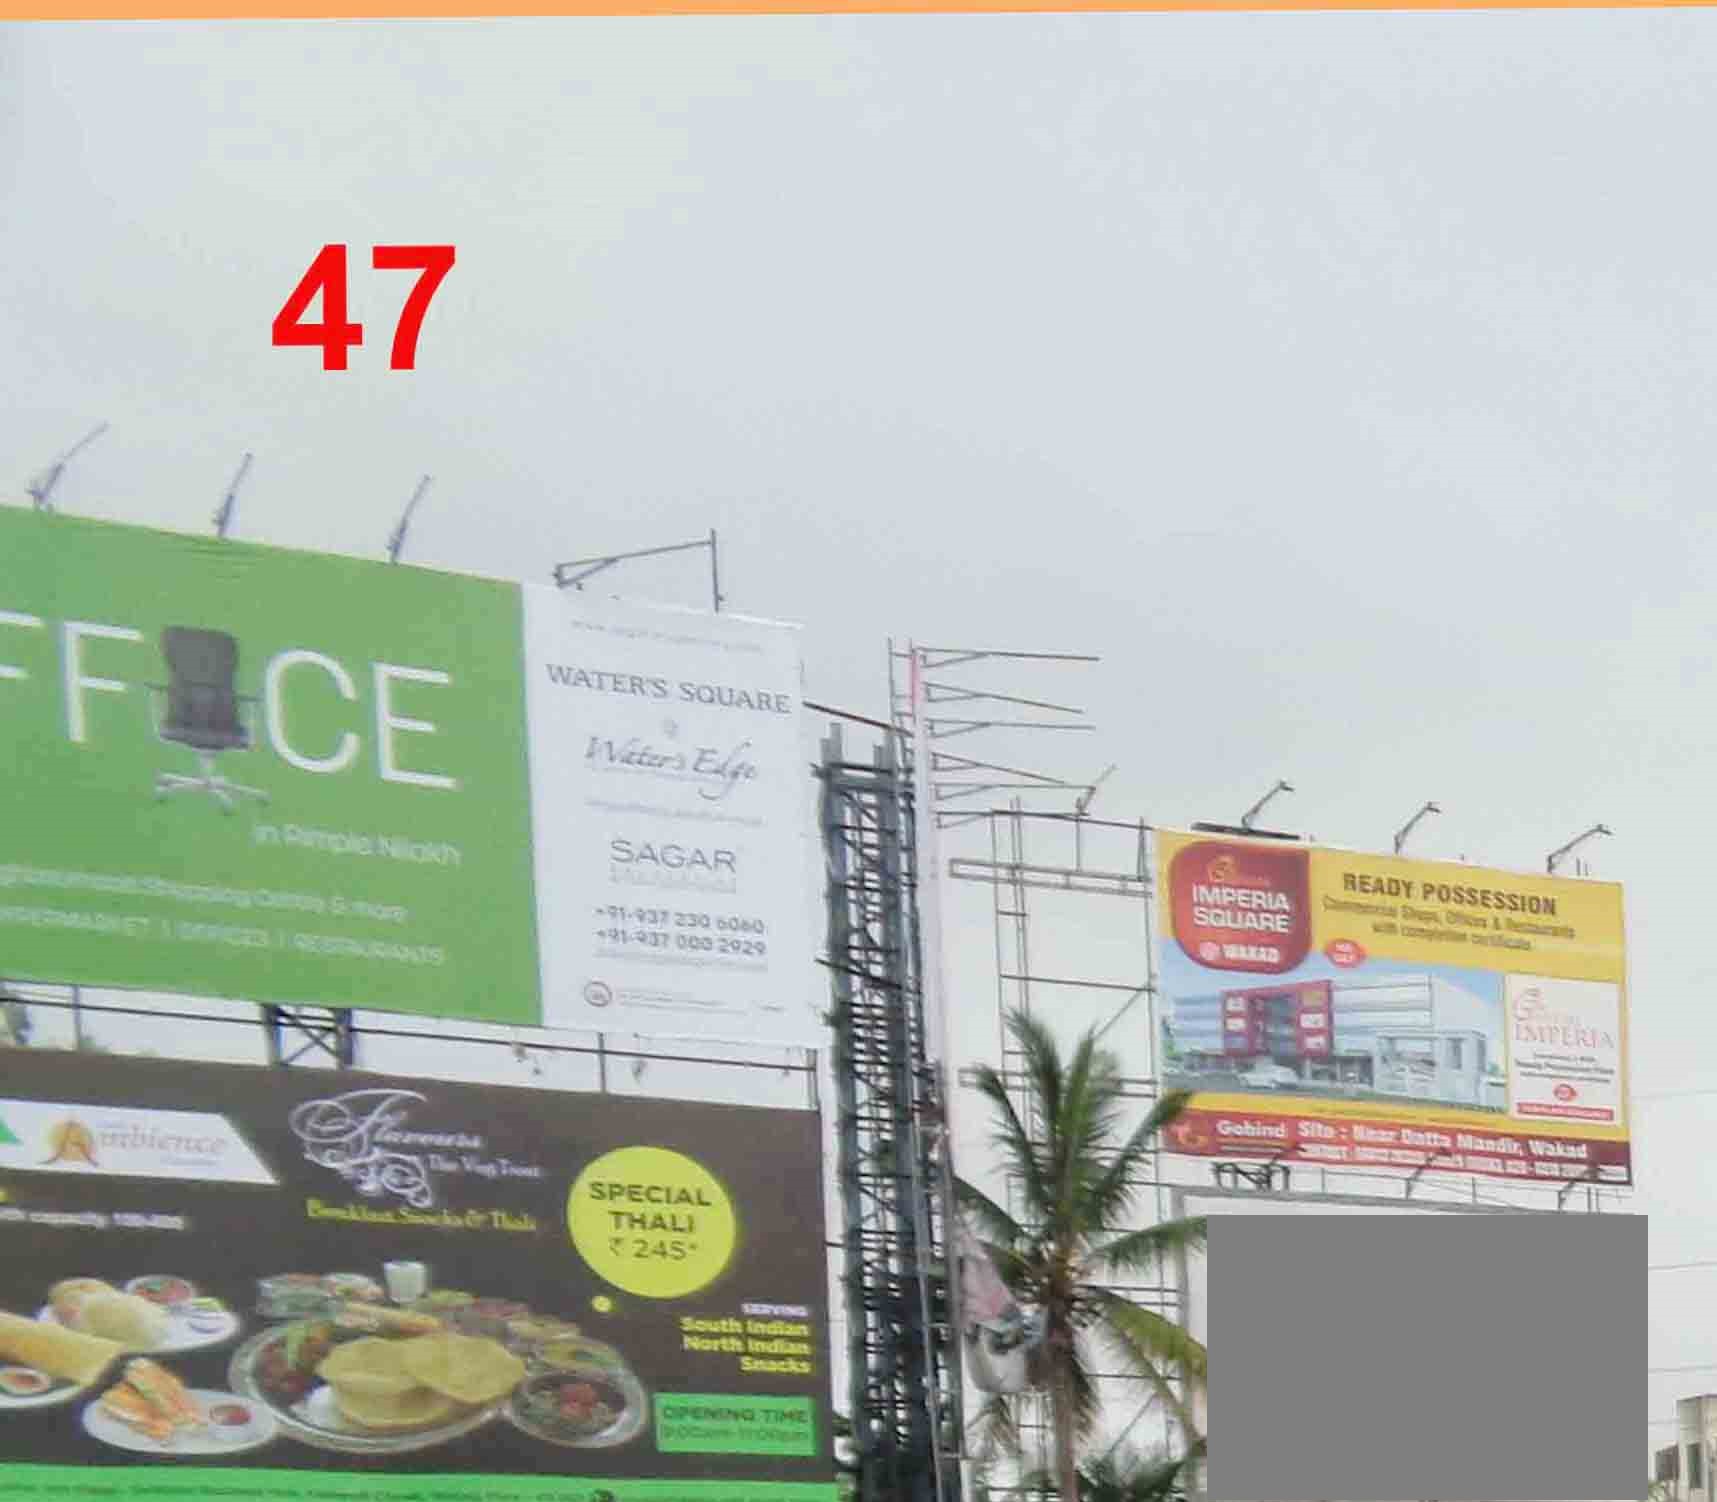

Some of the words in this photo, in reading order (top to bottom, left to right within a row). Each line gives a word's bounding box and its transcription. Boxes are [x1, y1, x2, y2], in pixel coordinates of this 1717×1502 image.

[546, 664, 668, 699] WATER'S
[679, 680, 792, 714] SQUARE
[610, 839, 737, 873] SAGAR
[1192, 882, 1290, 913] IMPERIA
[1343, 872, 1416, 899] READY
[1423, 882, 1558, 917] POSSESSION
[1192, 906, 1290, 935] SQUARE
[1528, 1138, 1589, 1159] Wakad
[588, 1180, 713, 1208] SPECIAL
[607, 1209, 696, 1235] THALI
[680, 1316, 744, 1334] South
[746, 1318, 809, 1337] Indian
[683, 1336, 745, 1353] North
[747, 1337, 811, 1355] Indian
[740, 1356, 812, 1374] Snacks
